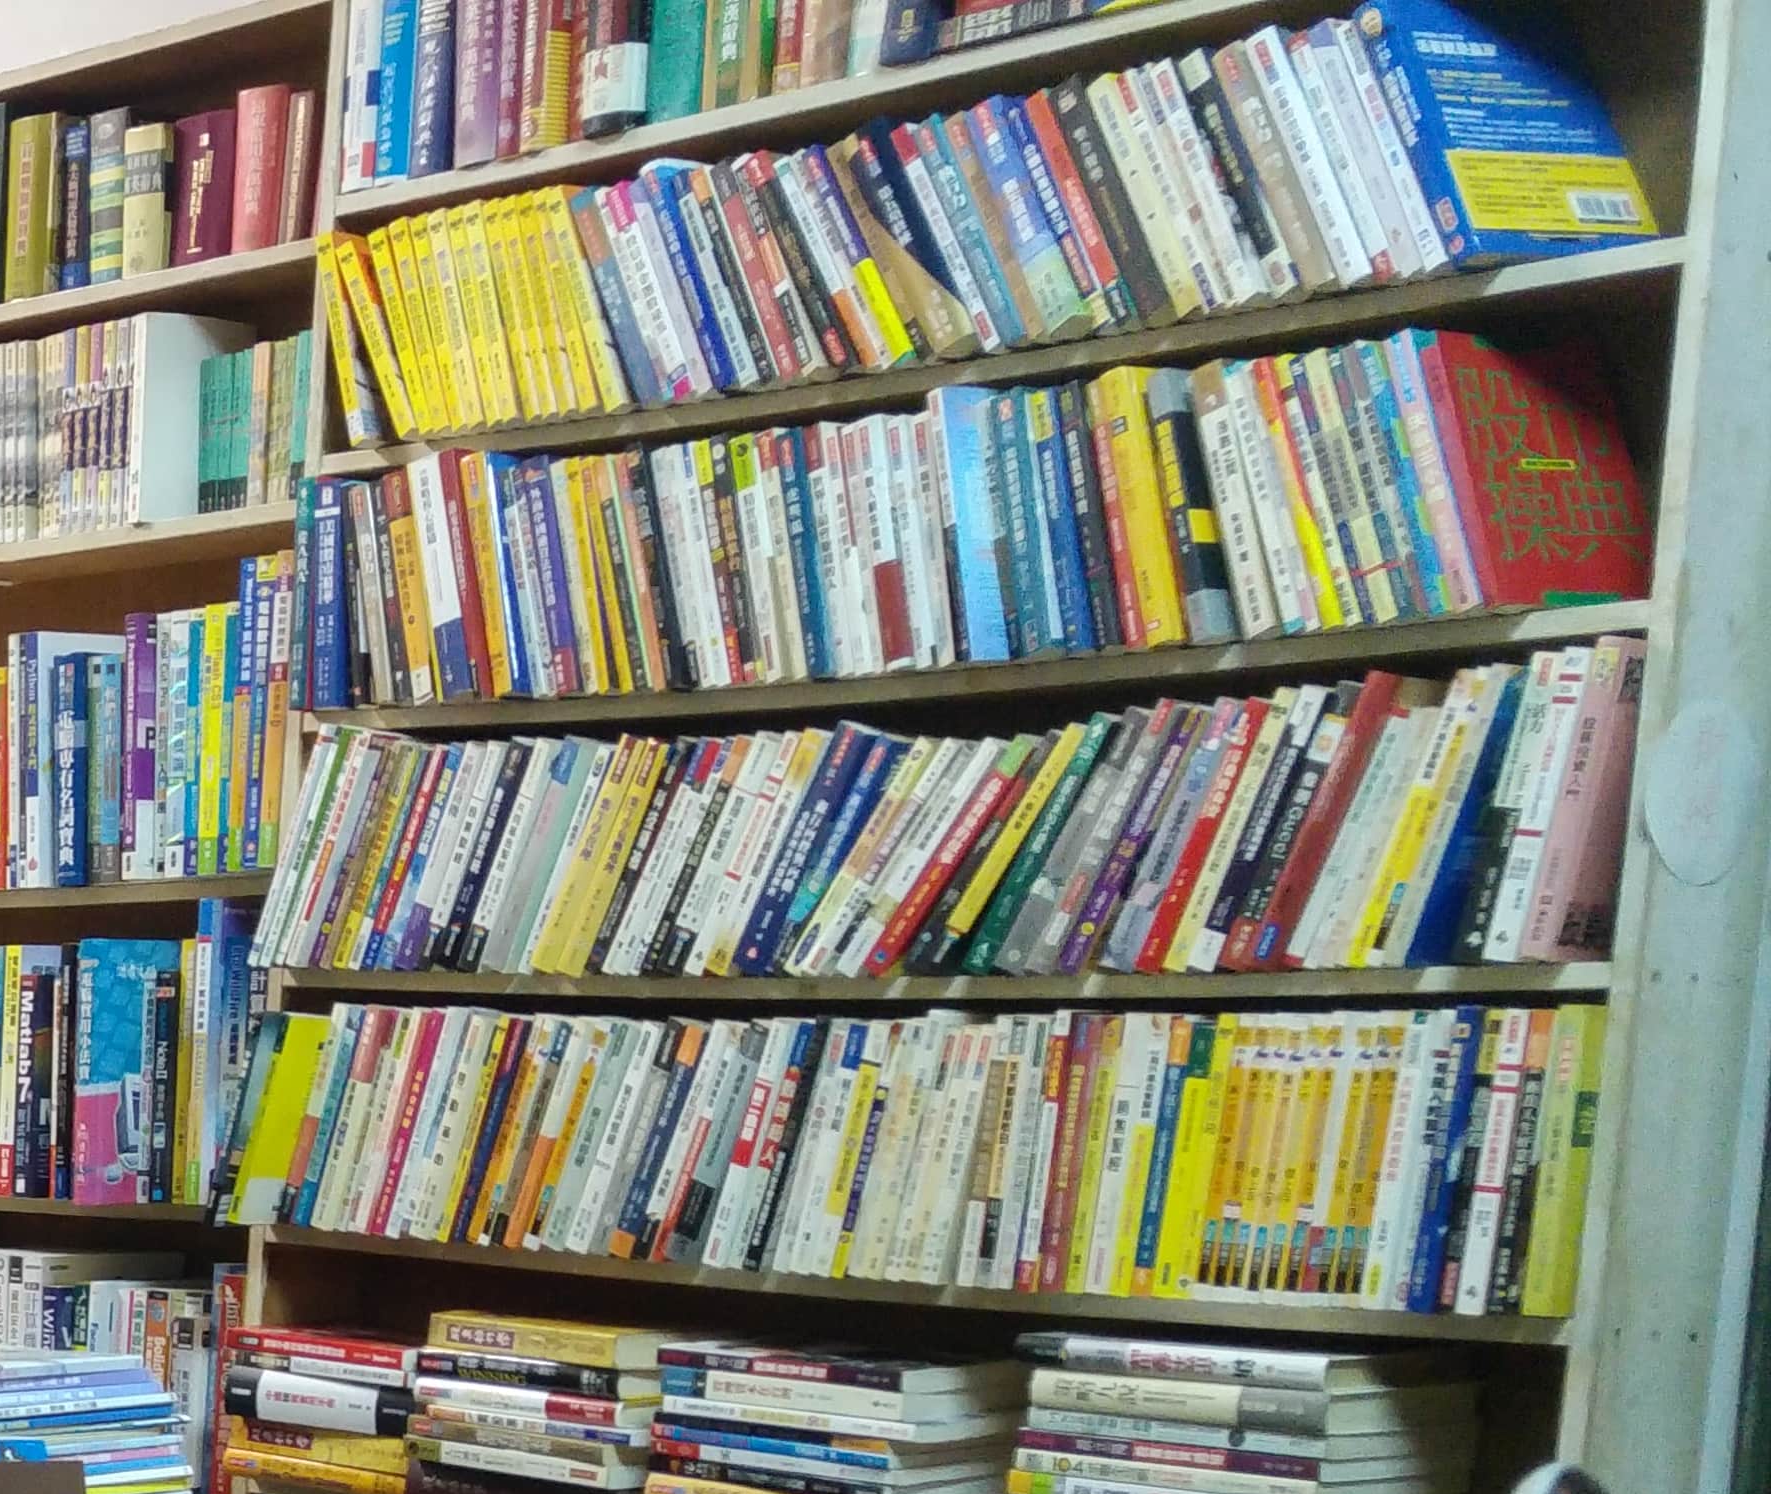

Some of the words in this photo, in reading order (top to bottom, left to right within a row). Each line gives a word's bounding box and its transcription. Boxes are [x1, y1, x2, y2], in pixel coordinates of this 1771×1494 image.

[27, 659, 38, 702] Python
[20, 990, 34, 1074] Matlab
[456, 1368, 527, 1386] WINNING
